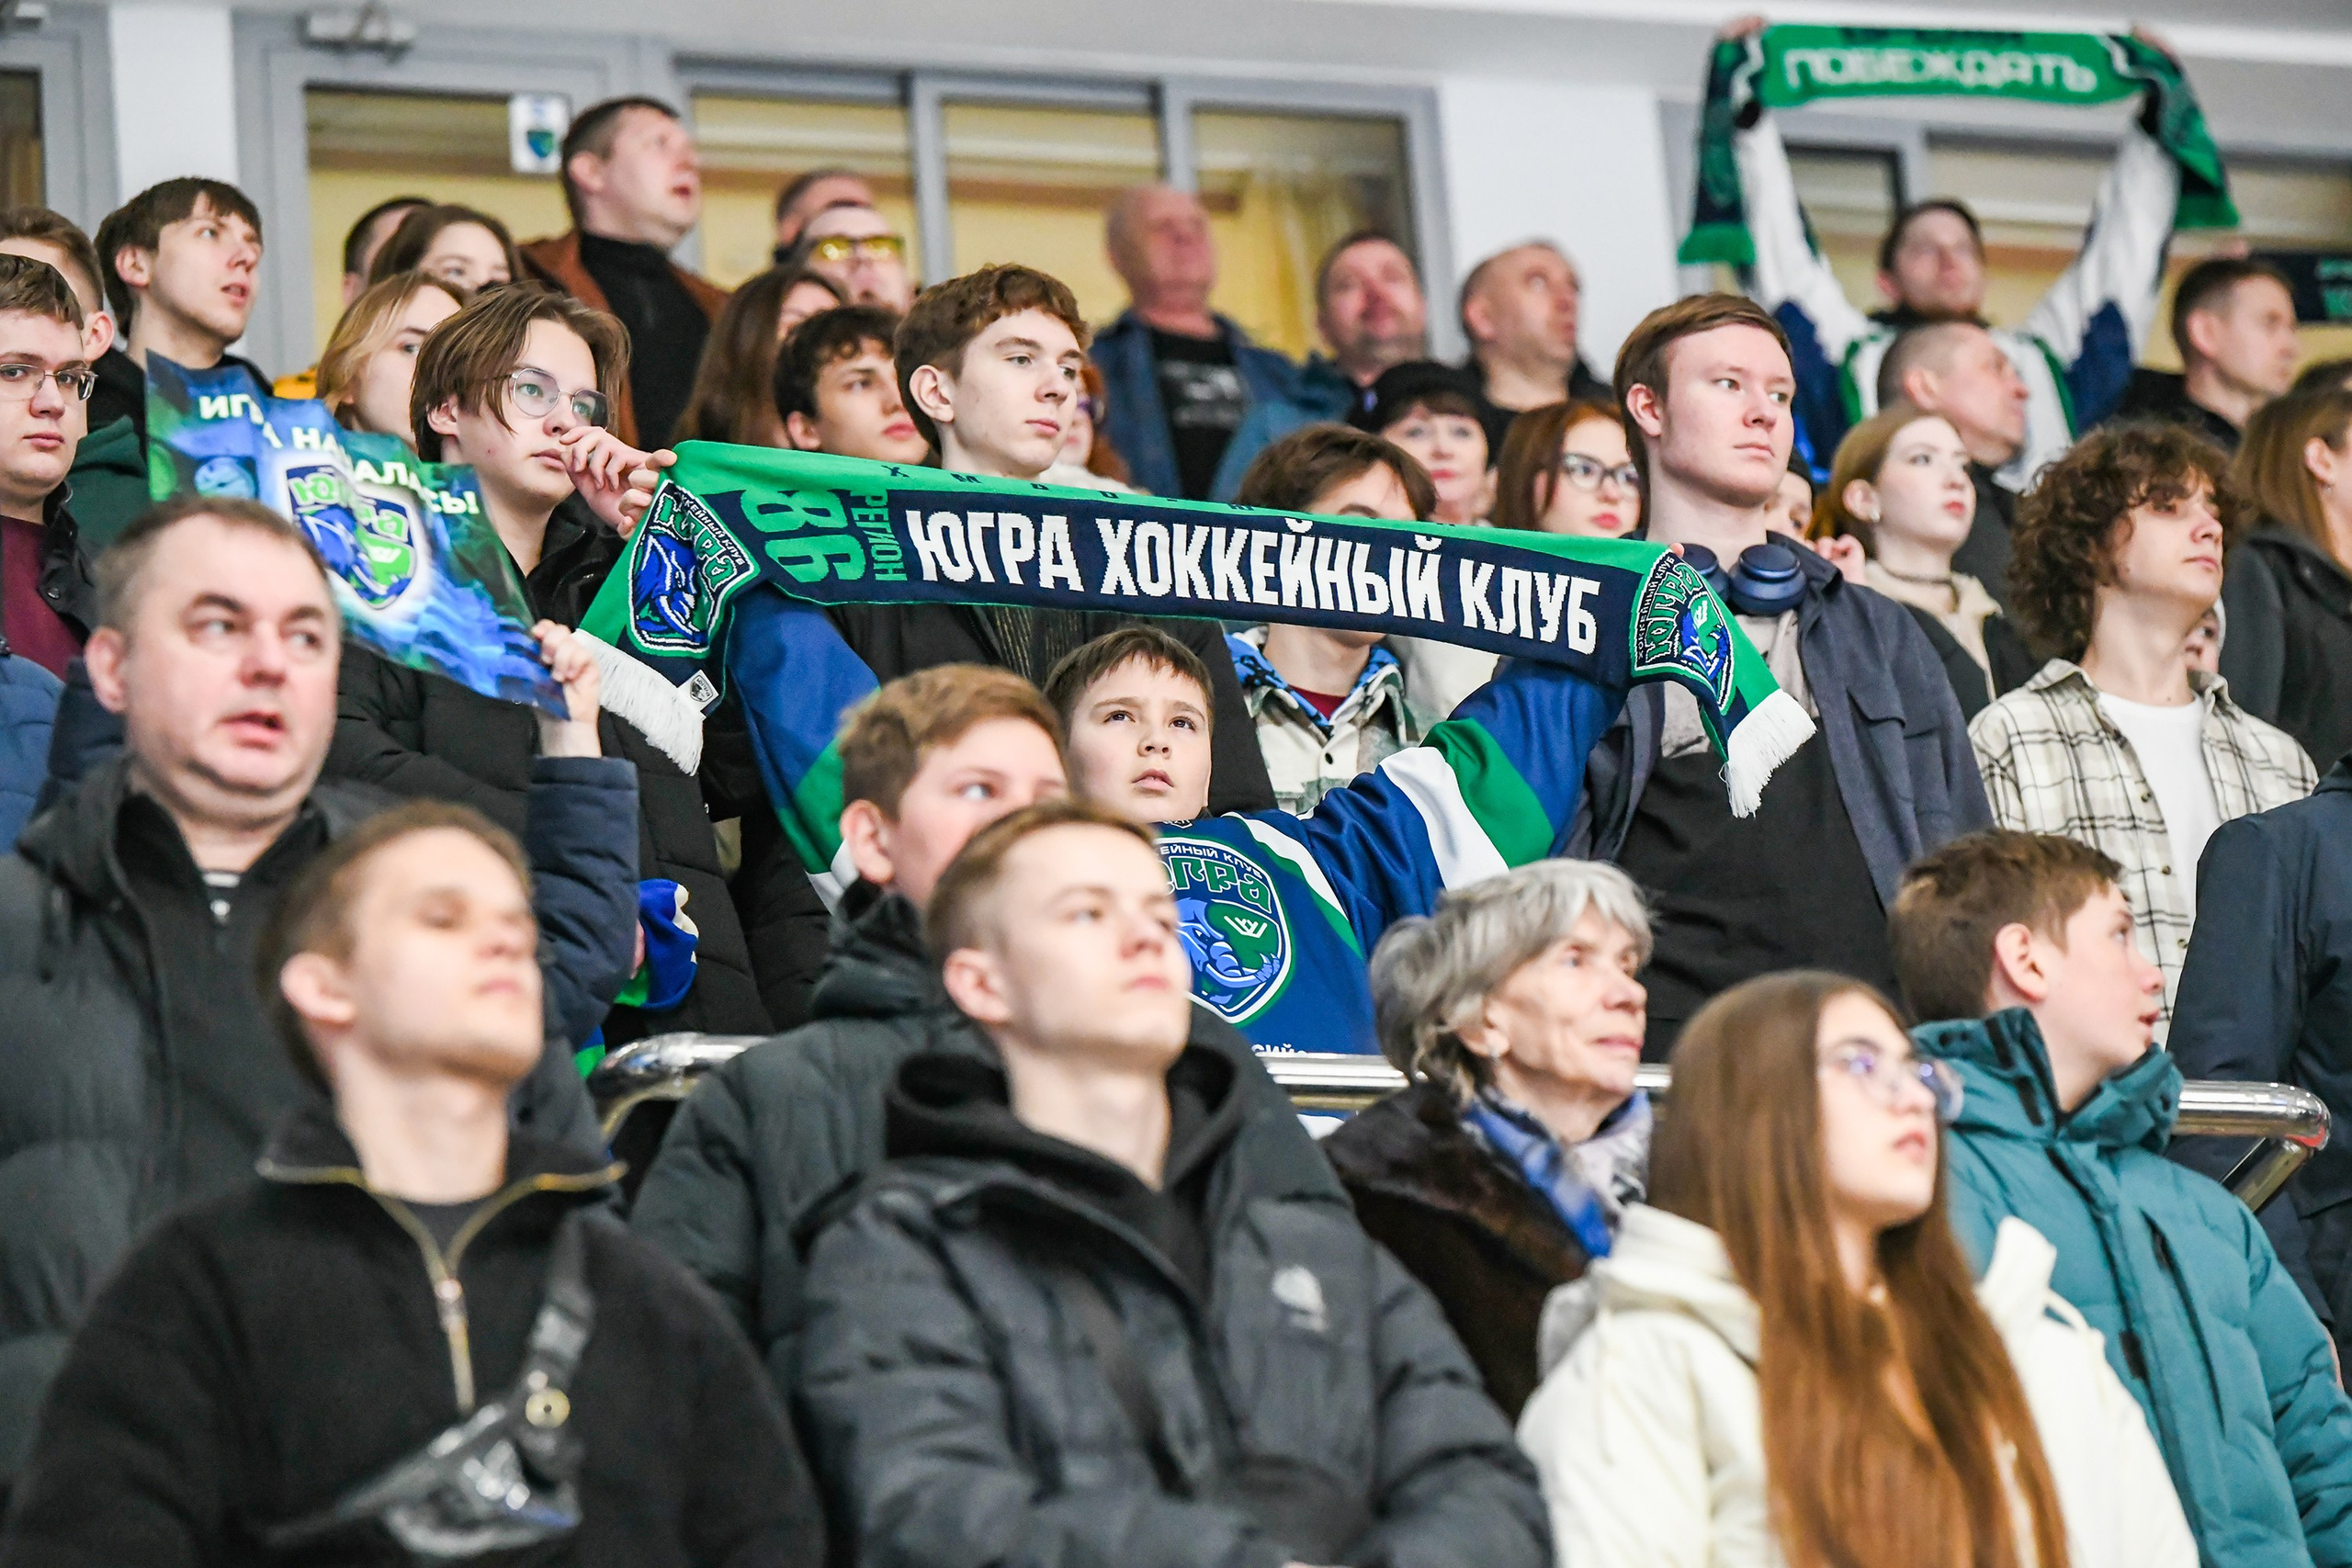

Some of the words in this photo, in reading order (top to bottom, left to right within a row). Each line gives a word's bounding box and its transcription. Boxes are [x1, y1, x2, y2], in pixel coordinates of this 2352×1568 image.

[721, 538, 746, 566] КЛУБ
[741, 490, 866, 583] 86
[850, 490, 908, 581] РЕГИОН
[905, 510, 1084, 592] ЮГРА
[1096, 516, 1443, 622] ХОККЕЙНЫЙ
[1463, 558, 1600, 656] КЛУБ
[1655, 556, 1675, 580] КЛУБ
[1159, 844, 1218, 858] ЕЙНЫЙ
[1223, 852, 1263, 879] КЛУБ
